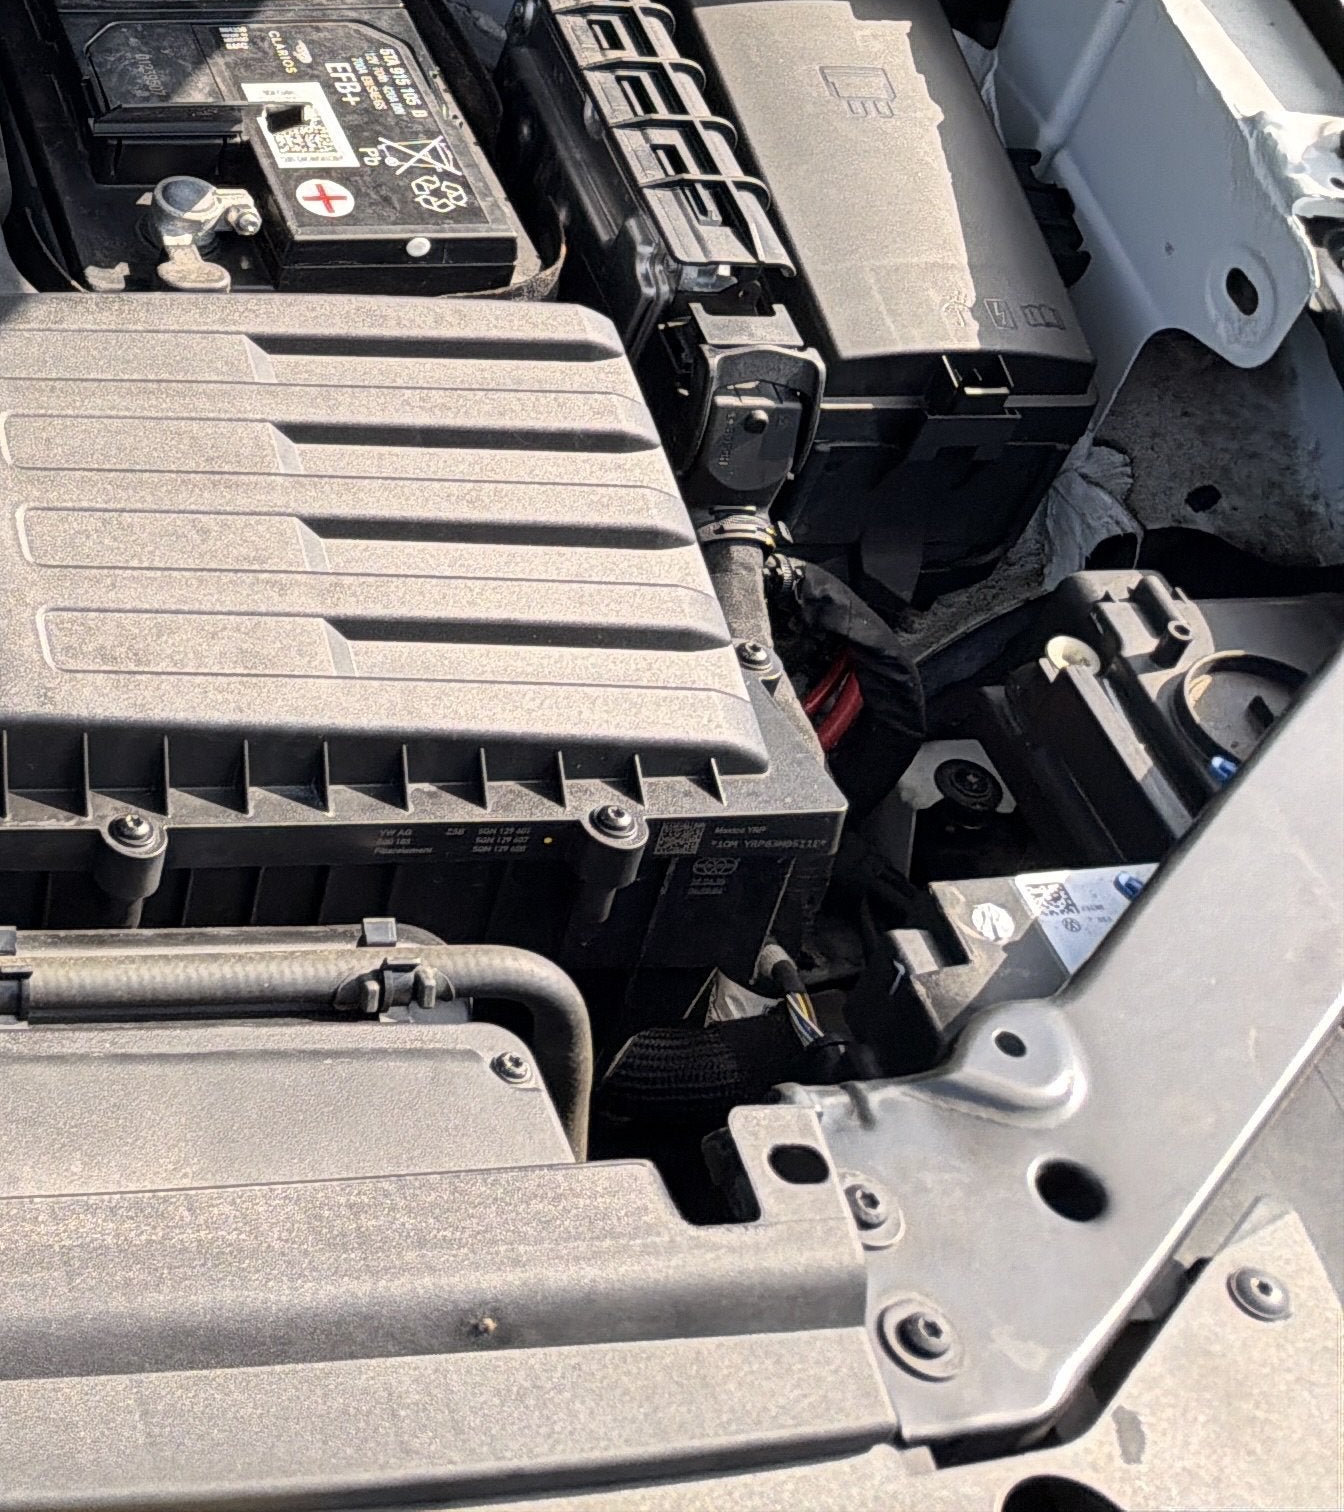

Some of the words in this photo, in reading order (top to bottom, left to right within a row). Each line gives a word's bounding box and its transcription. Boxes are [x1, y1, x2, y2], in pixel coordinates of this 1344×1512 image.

[267, 29, 298, 75] CLARIOS
[324, 61, 359, 107] EFB+
[389, 66, 411, 86] 915
[399, 87, 422, 107] 105
[361, 146, 383, 168] Pb
